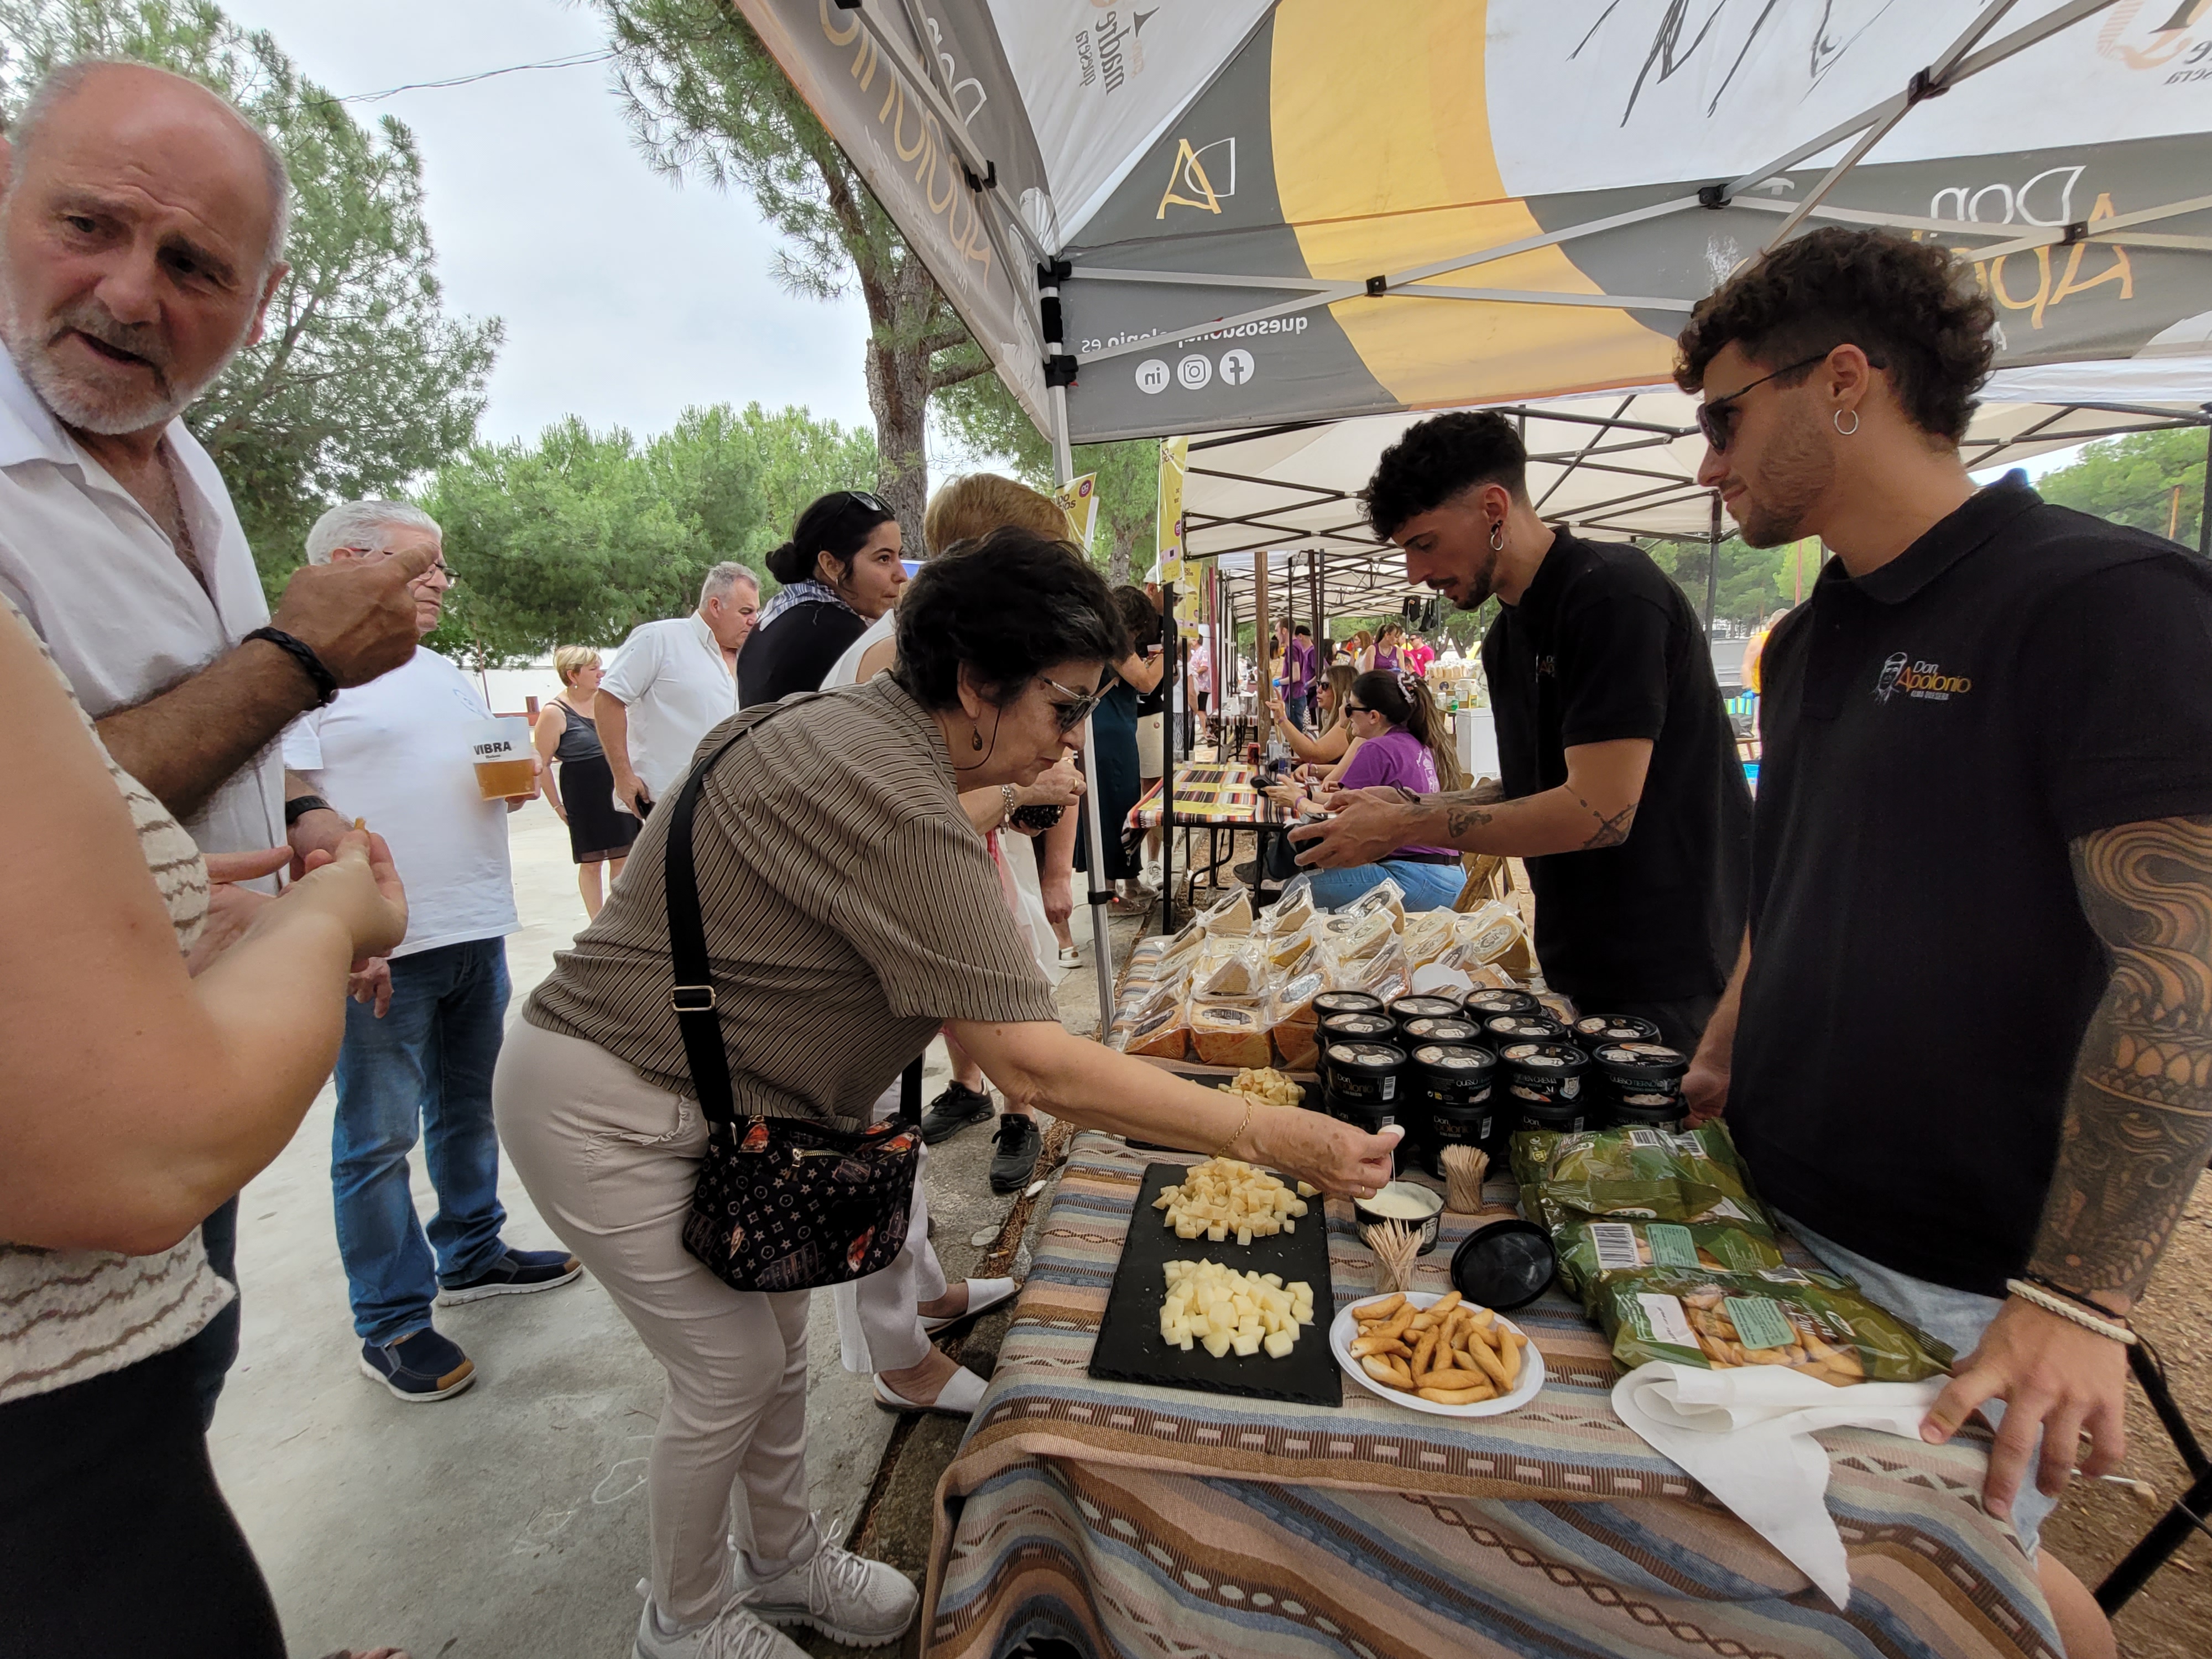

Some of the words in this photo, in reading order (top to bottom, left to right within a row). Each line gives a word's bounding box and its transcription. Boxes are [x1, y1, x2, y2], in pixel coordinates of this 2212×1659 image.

[1912, 660, 1939, 674] Don
[1894, 666, 1973, 693] Apolonio
[473, 741, 512, 755] VIBRA
[1337, 1073, 1350, 1083] Don
[1336, 1081, 1374, 1093] polonio
[1433, 1115, 1449, 1125] Don
[1523, 1115, 1540, 1125] Don
[1433, 1121, 1473, 1134] polonio
